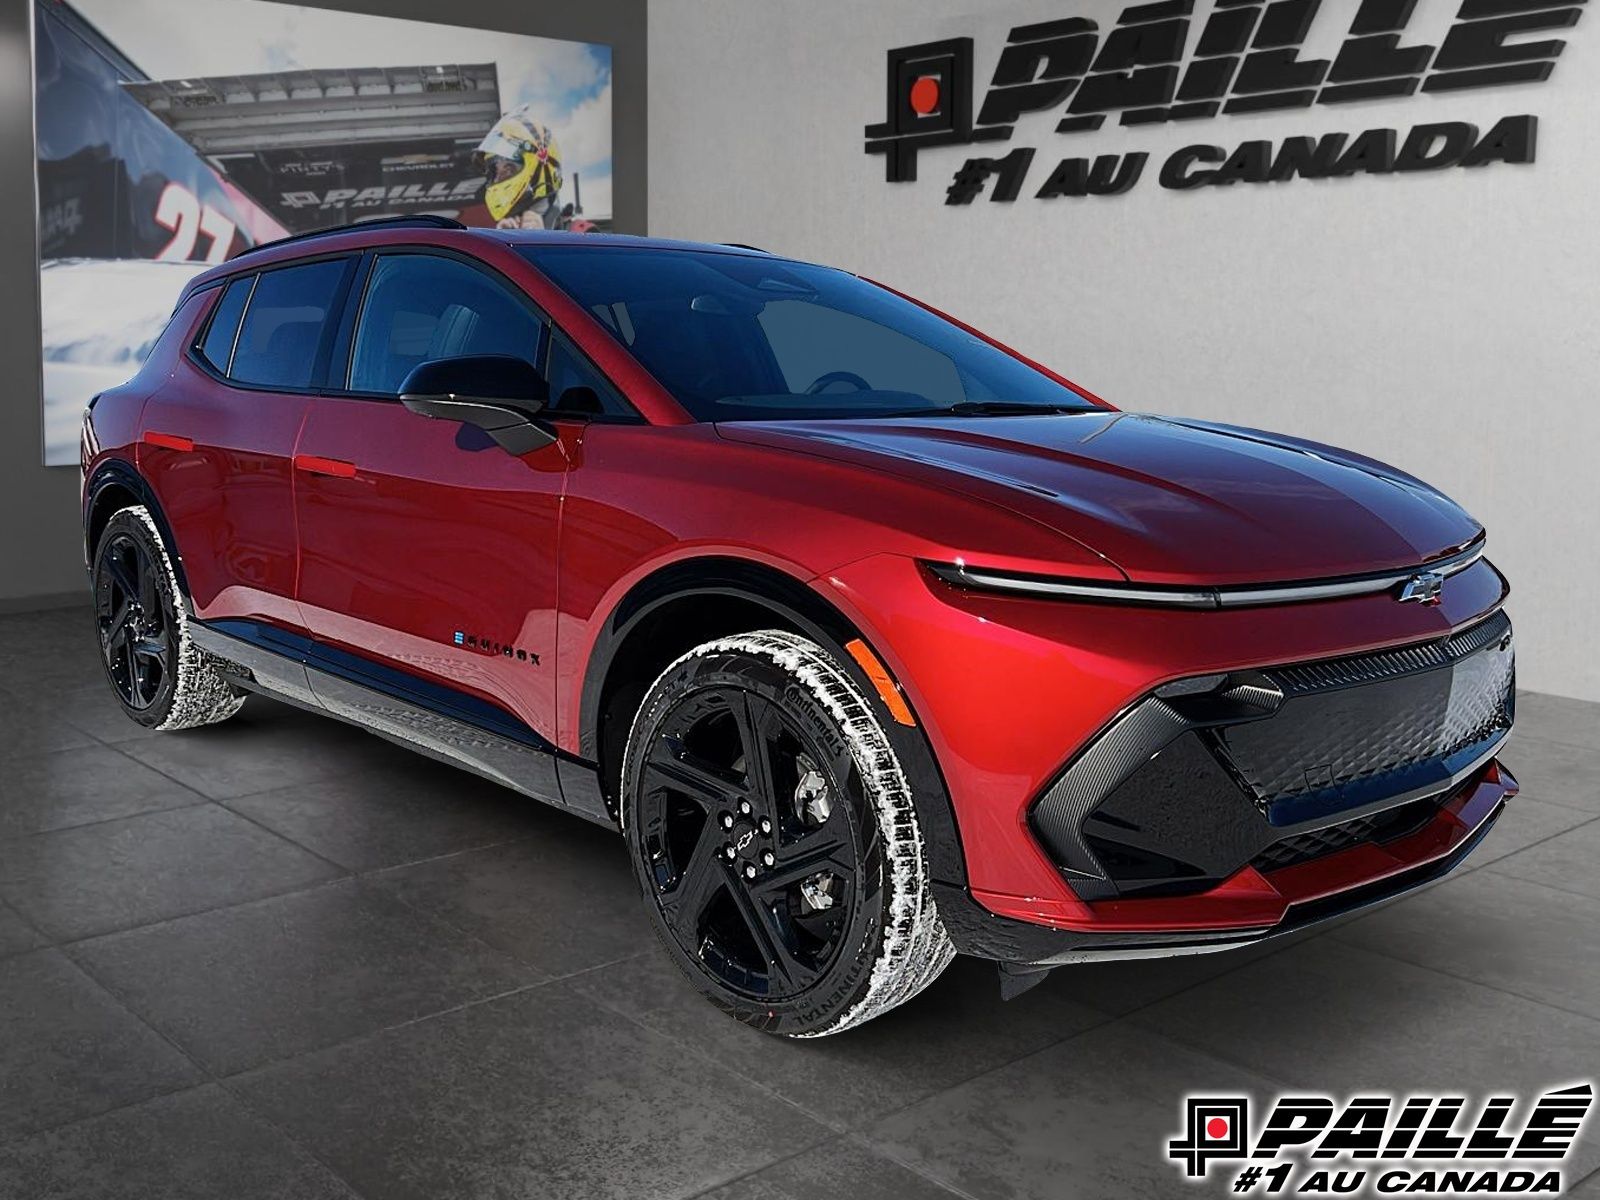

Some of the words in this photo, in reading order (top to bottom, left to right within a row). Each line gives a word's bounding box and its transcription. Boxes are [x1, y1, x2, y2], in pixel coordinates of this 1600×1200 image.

[381, 162, 455, 173] CHEVROLET
[944, 147, 1036, 206] #1
[1035, 152, 1150, 199] AU
[1158, 114, 1538, 191] CANADA
[154, 181, 236, 262] 27
[351, 199, 382, 208] AU
[388, 194, 476, 206] CANADA
